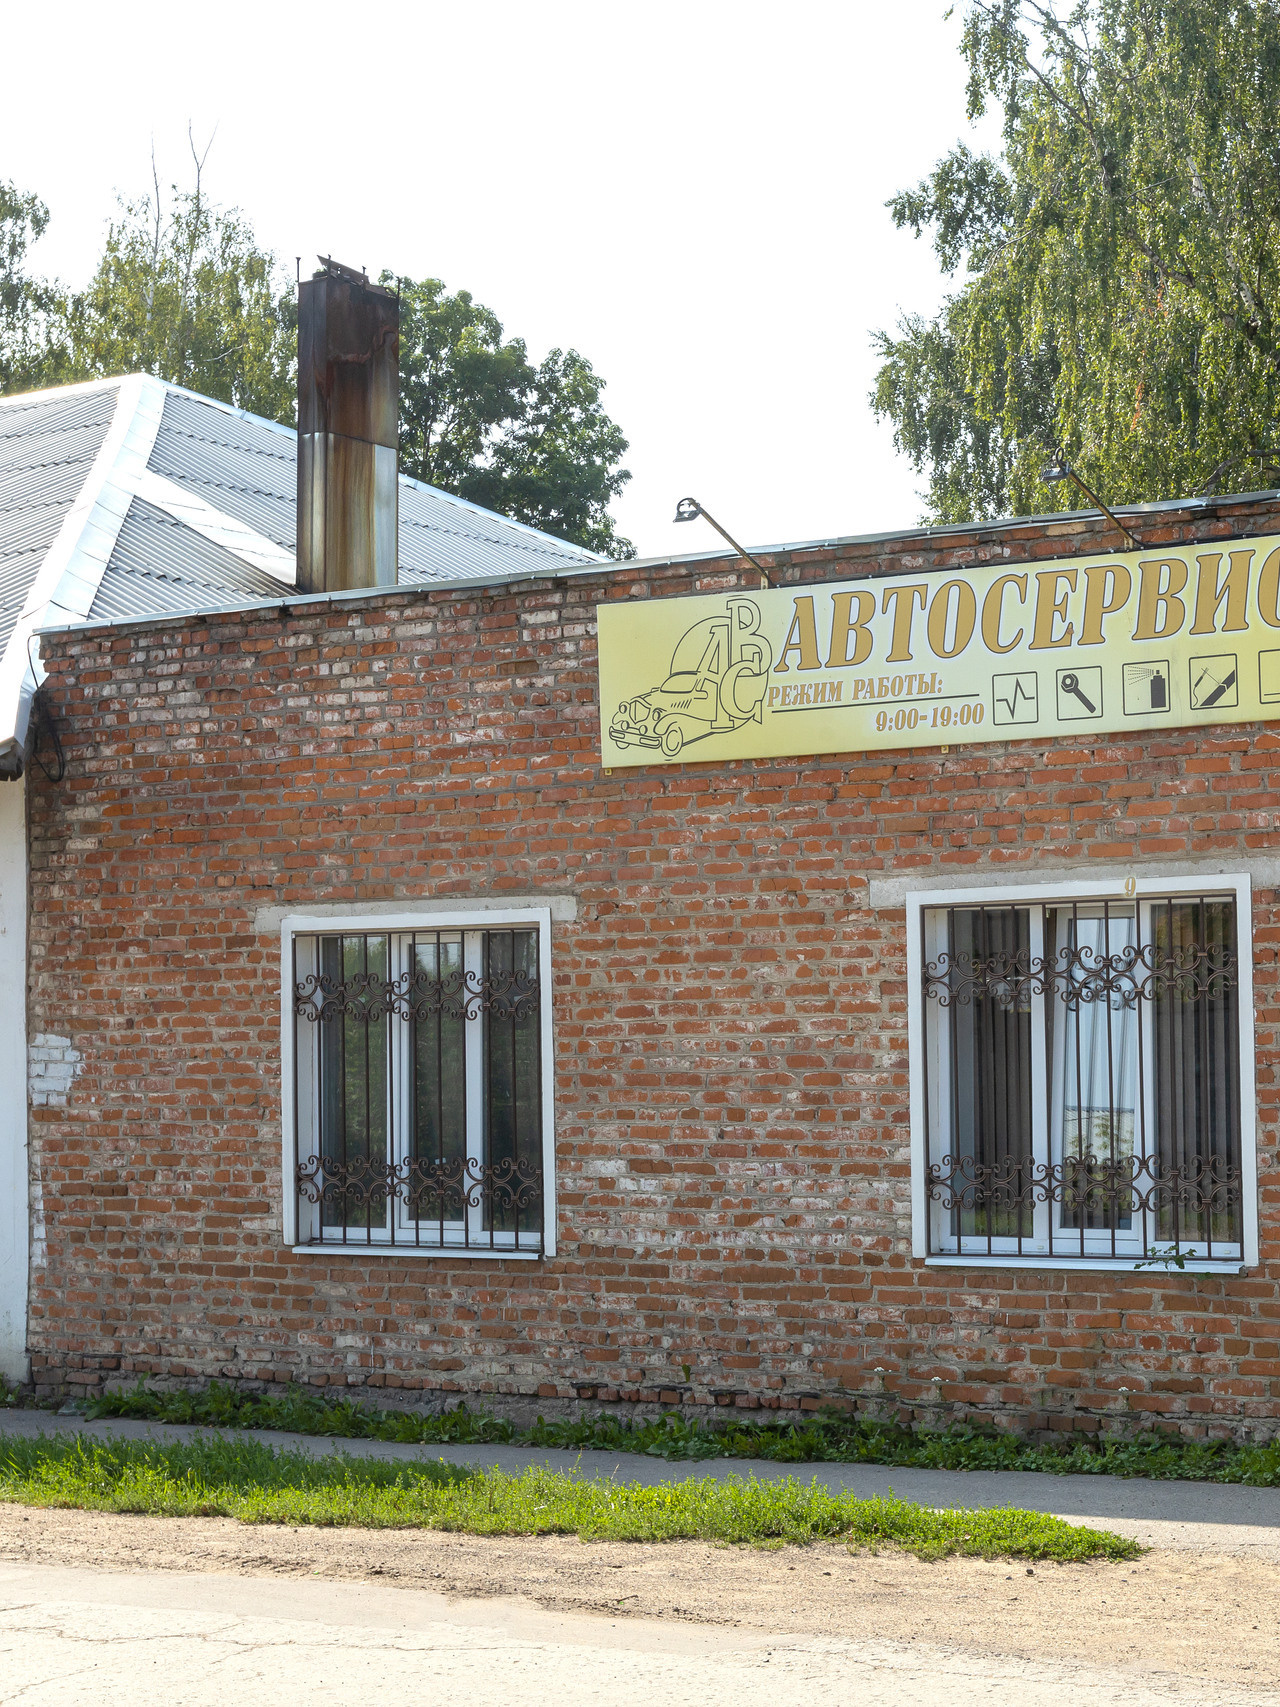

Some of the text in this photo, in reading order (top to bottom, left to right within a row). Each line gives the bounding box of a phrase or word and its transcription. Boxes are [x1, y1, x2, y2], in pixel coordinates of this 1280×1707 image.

[767, 672, 943, 708] РЕЖИМ РАБОТЫ:
[875, 702, 985, 732] 9:00-19:00
